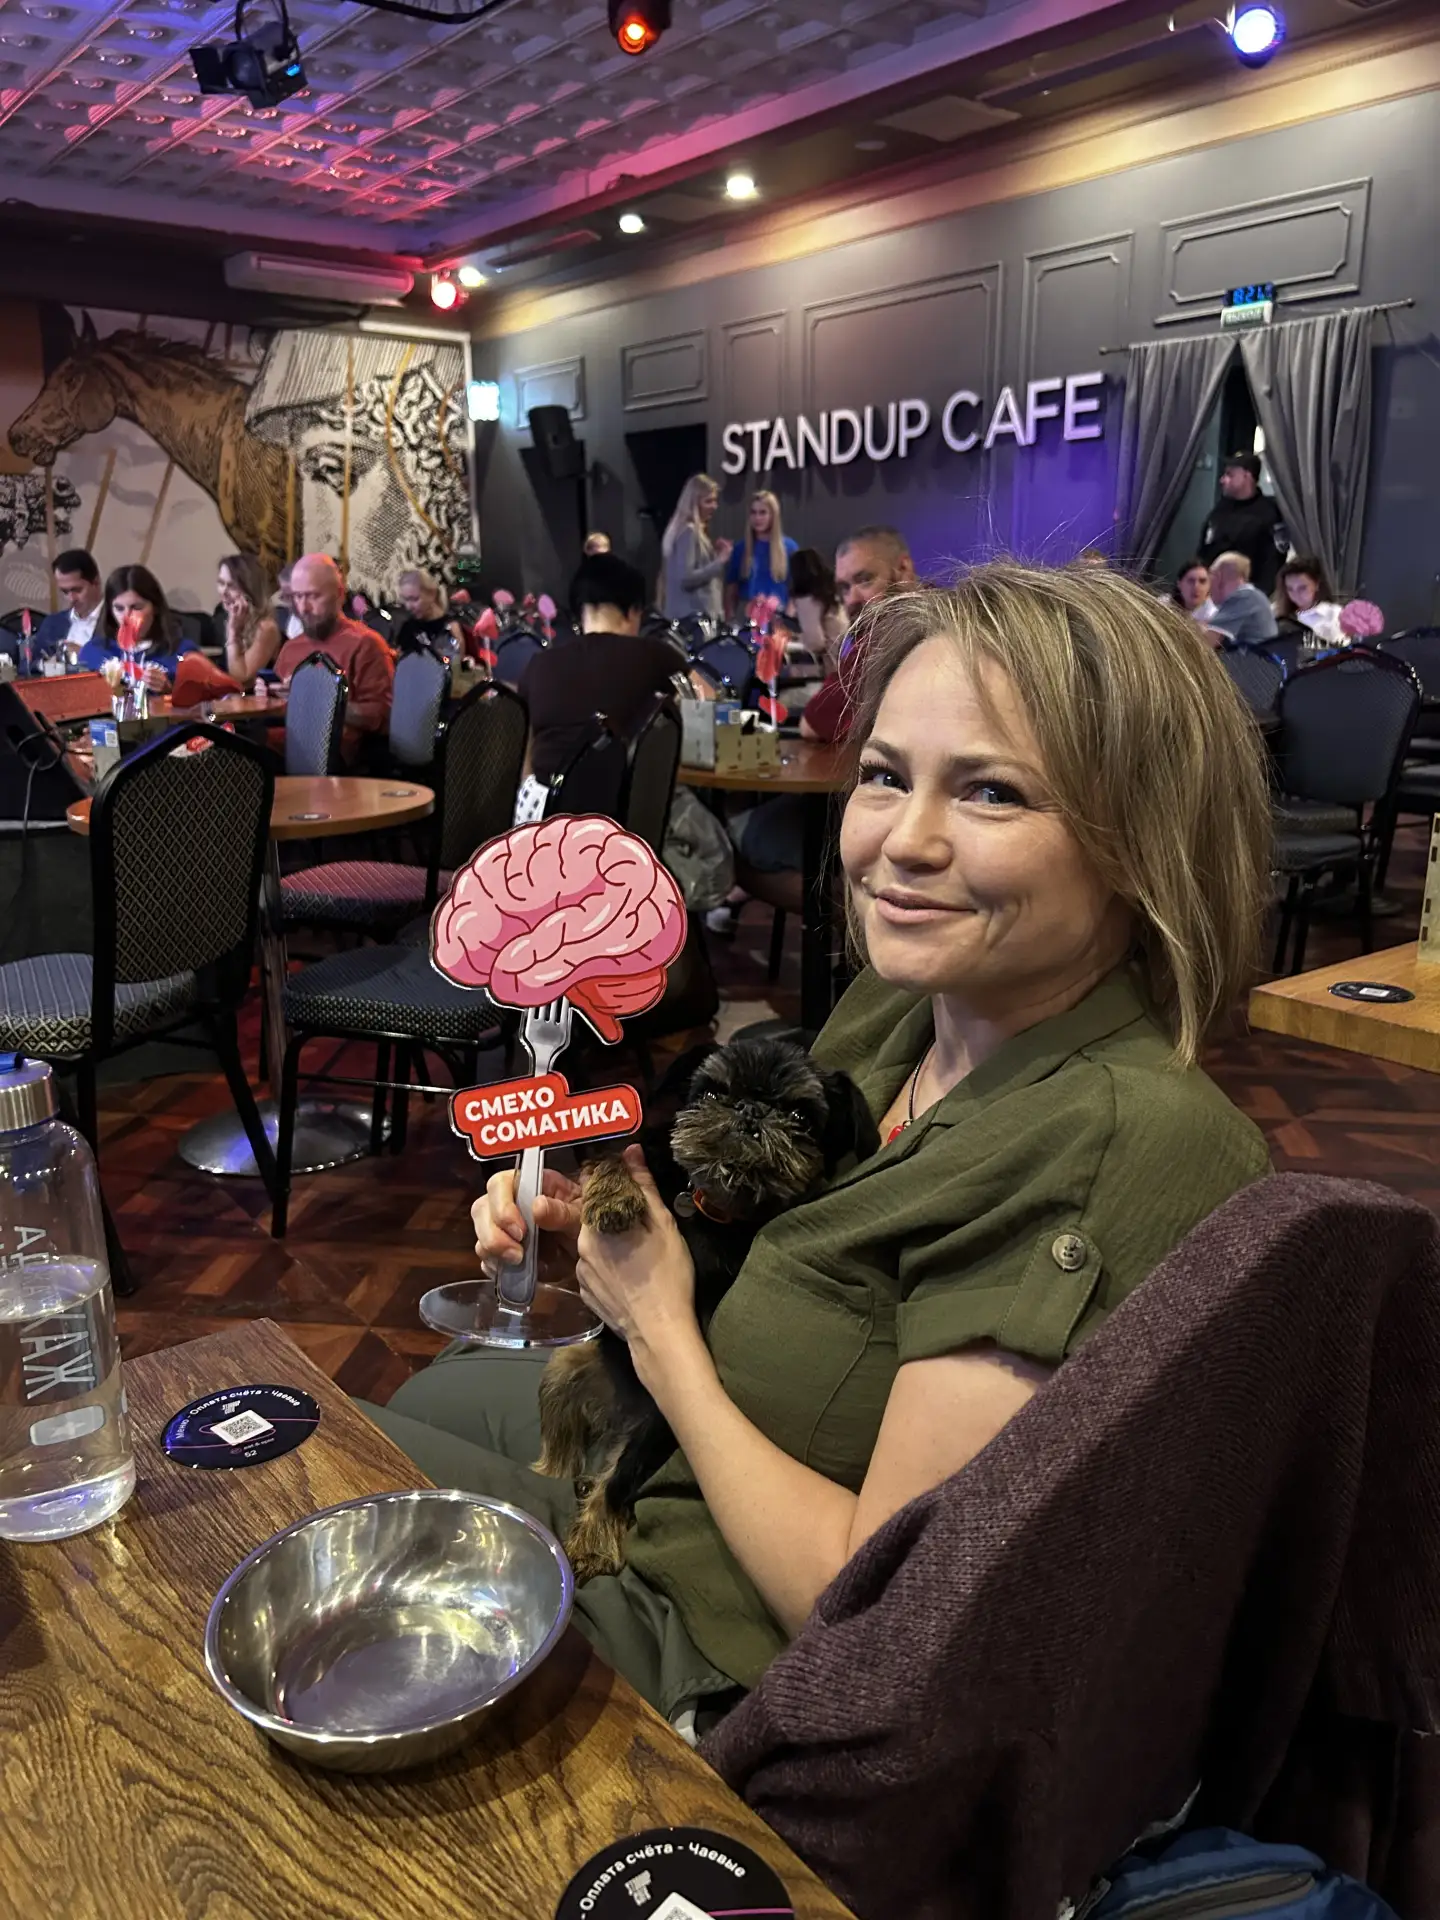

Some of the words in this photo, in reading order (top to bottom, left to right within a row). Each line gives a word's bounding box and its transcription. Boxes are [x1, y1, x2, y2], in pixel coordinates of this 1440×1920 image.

[721, 399, 930, 474] STANDUP
[941, 372, 1105, 452] CAFE
[465, 1086, 555, 1122] СМЕХО
[480, 1099, 630, 1145] СОМАТИКА
[175, 1418, 190, 1440] Меню
[190, 1395, 228, 1416] Оплата
[229, 1389, 262, 1399] счёта
[271, 1390, 301, 1408] Чаевые
[579, 1860, 626, 1911] Оплата
[625, 1842, 674, 1864] счёта
[688, 1842, 746, 1878] Чаевые
